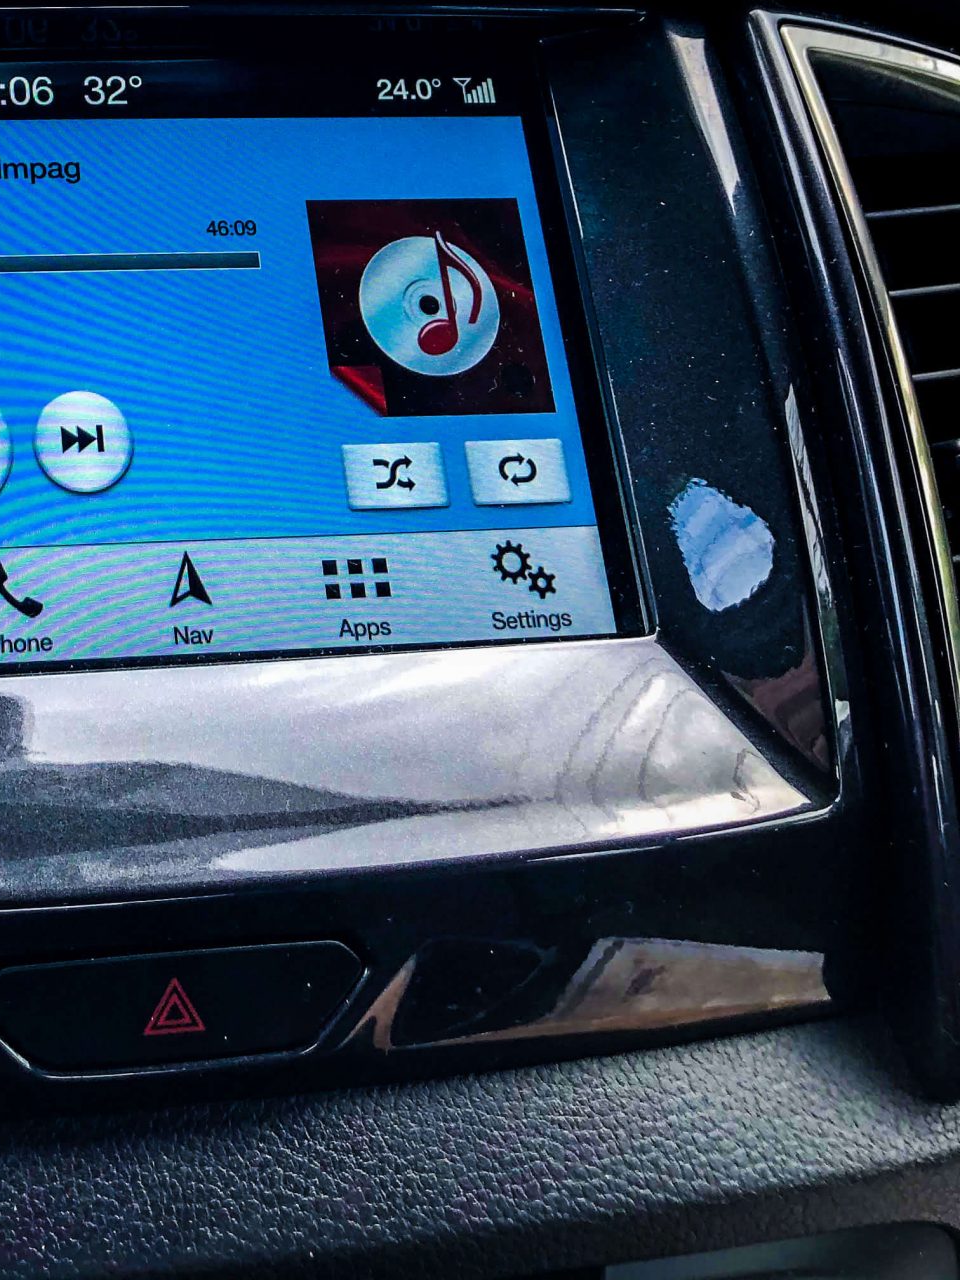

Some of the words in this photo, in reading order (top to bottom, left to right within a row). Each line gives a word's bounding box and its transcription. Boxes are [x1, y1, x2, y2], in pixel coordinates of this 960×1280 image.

[83, 75, 143, 107] 32°
[375, 78, 442, 101] 24.0°
[206, 219, 258, 238] 46:09
[338, 619, 392, 642] Apps
[490, 609, 573, 633] Settings
[173, 625, 214, 646] Nav
